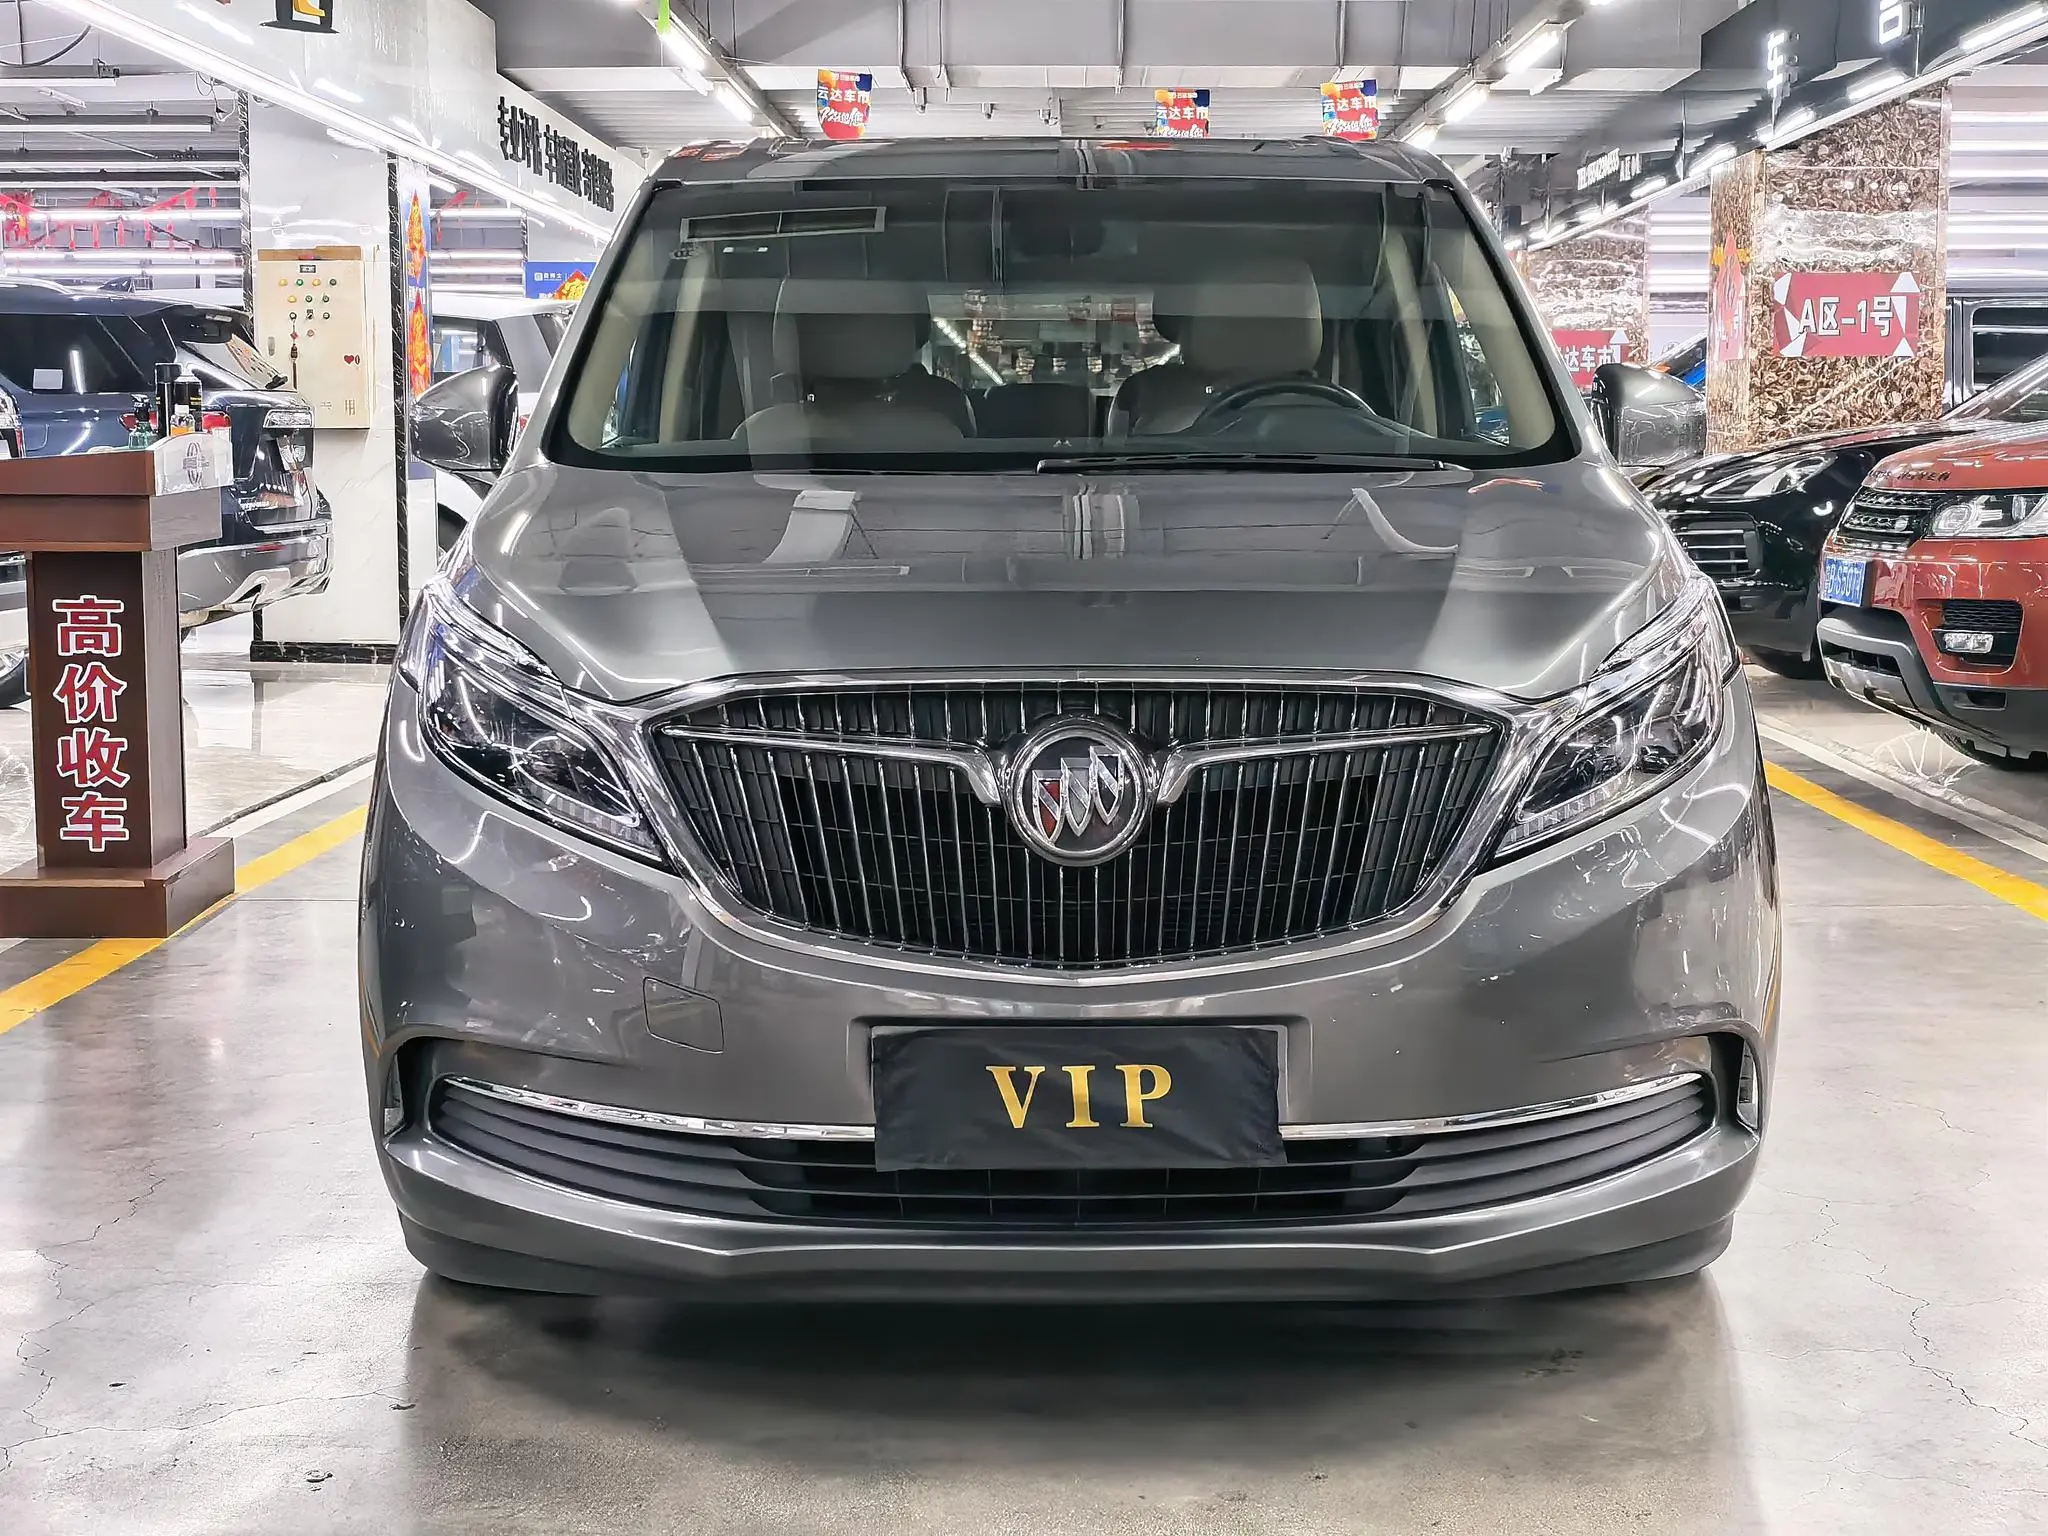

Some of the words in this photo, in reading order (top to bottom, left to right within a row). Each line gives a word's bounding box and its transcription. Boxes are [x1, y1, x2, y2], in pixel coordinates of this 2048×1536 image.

[818, 86, 871, 106] 云达车市
[1321, 97, 1377, 112] 云达车市
[1156, 106, 1209, 120] 云达车市
[1798, 296, 1894, 337] A区-1号
[1558, 344, 1613, 373] 达车市
[52, 594, 130, 853] 高价收车
[985, 1064, 1173, 1129] VIP
